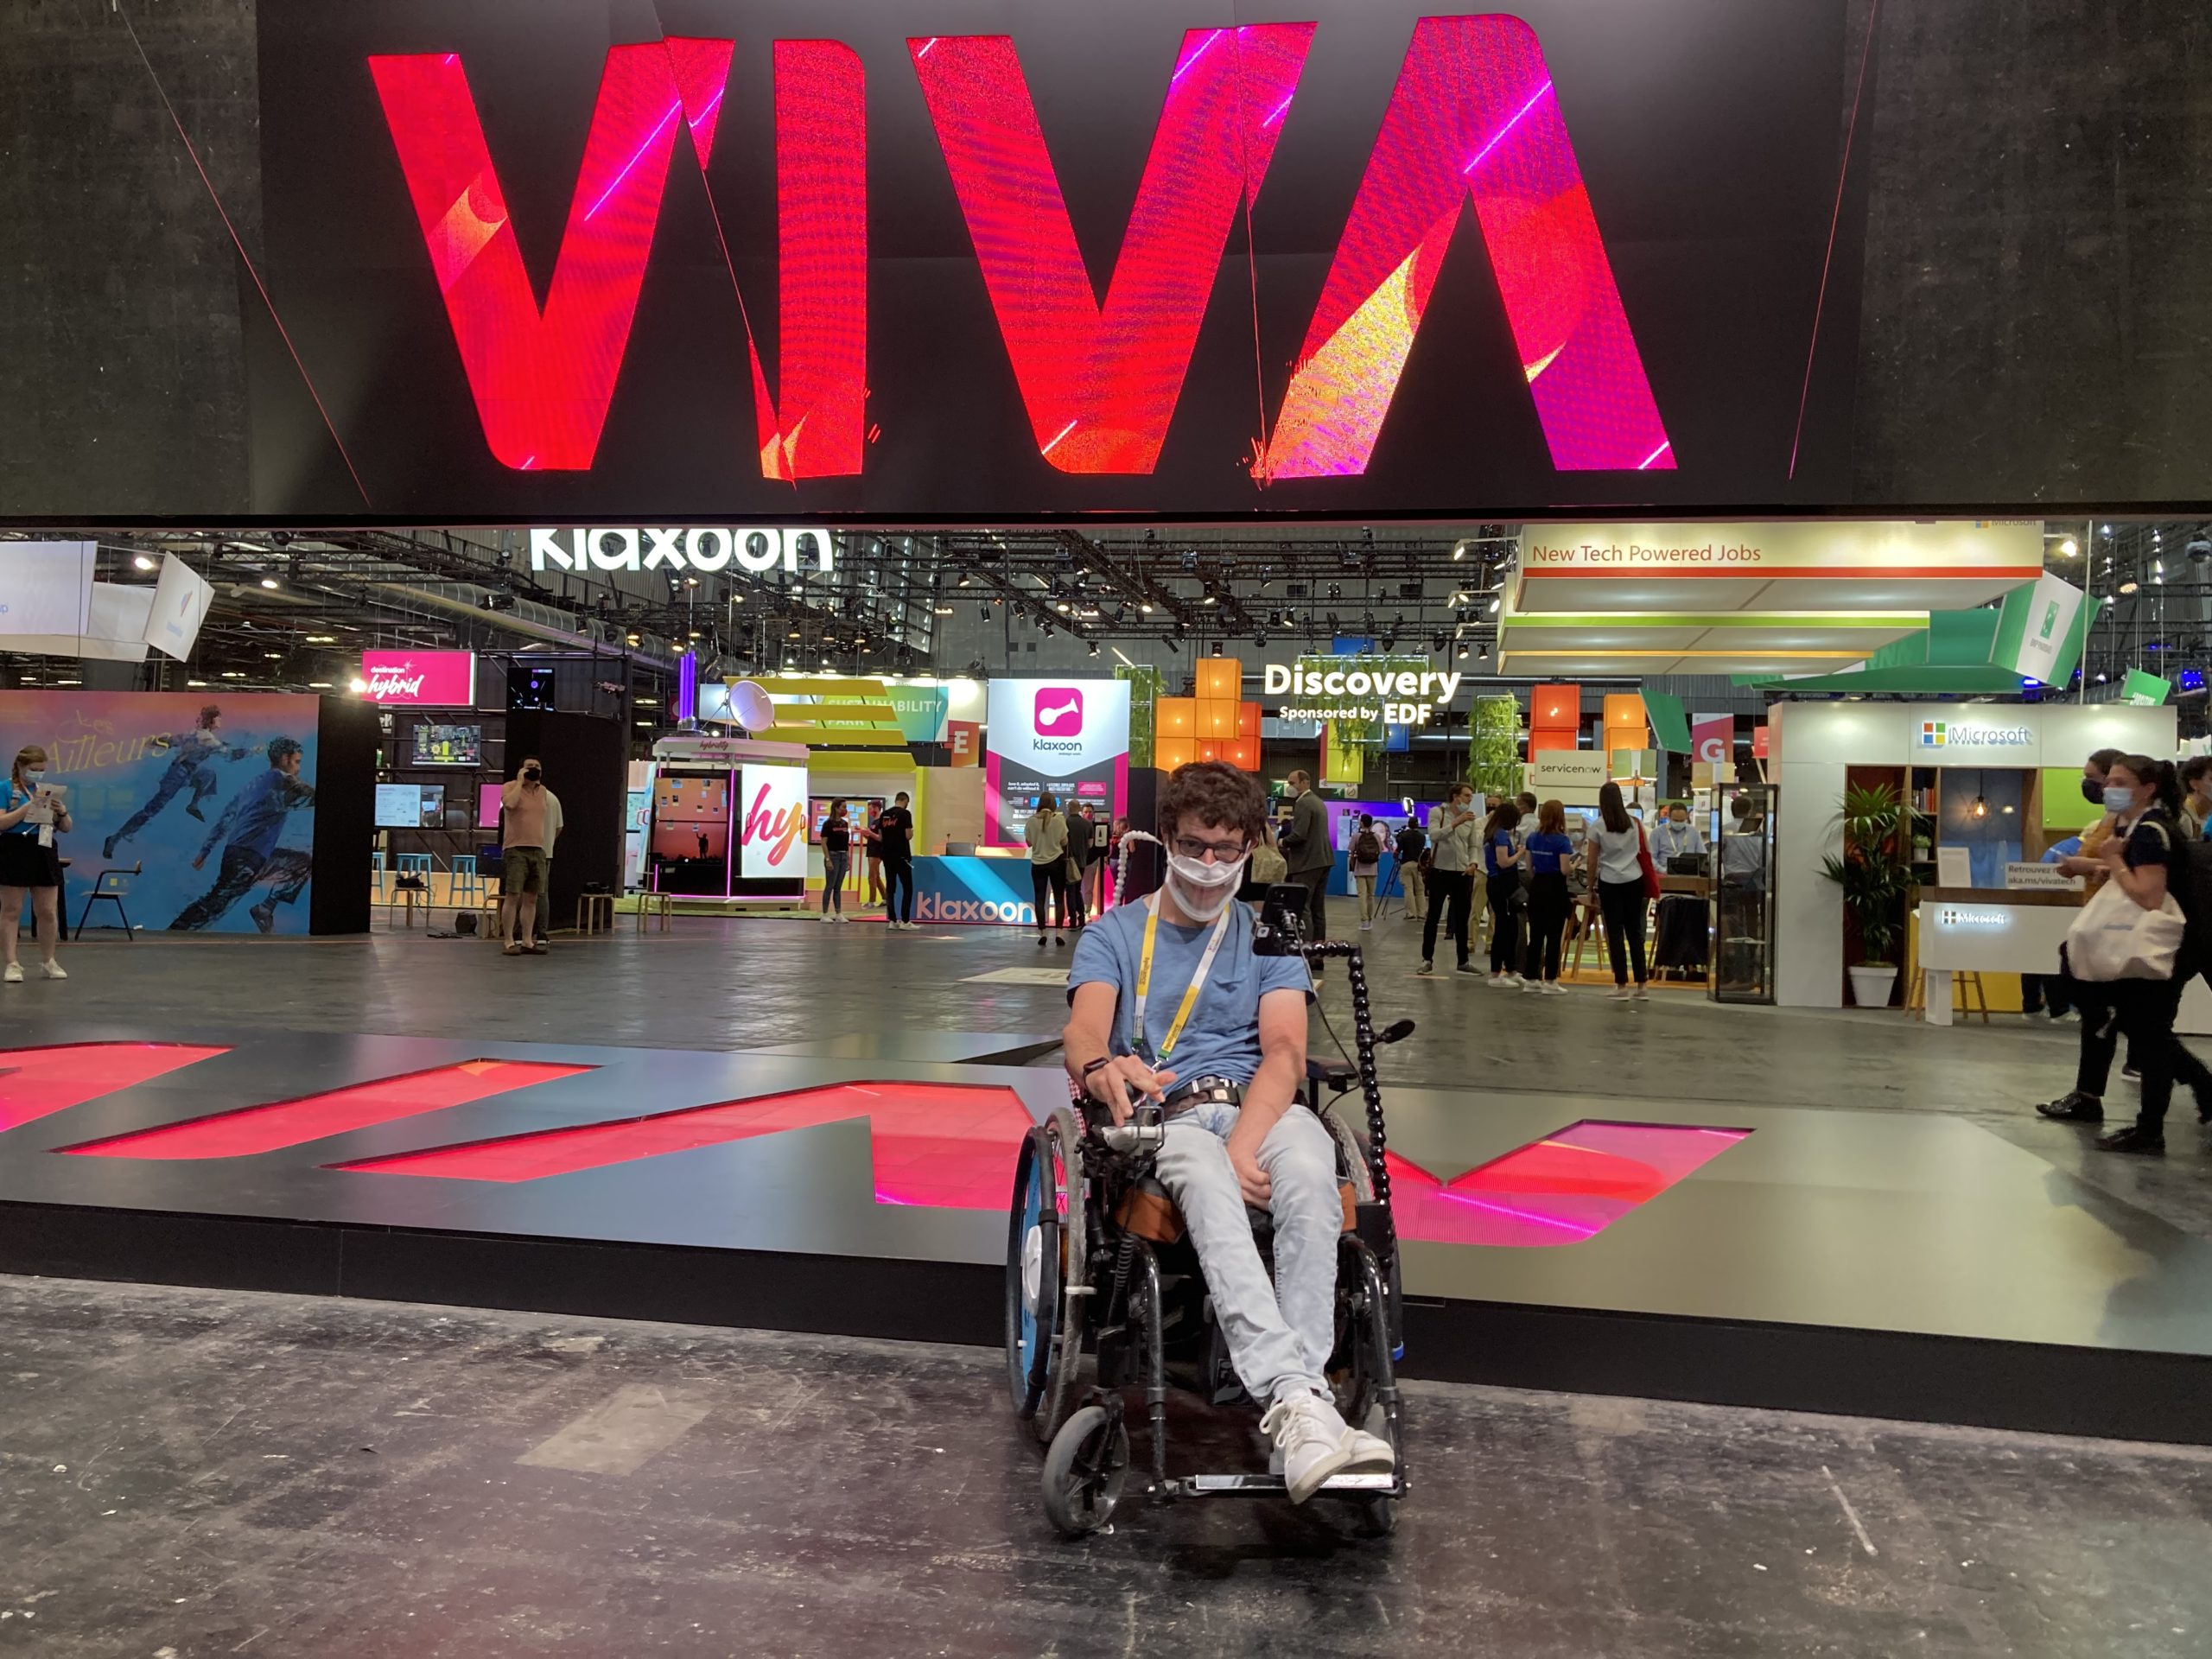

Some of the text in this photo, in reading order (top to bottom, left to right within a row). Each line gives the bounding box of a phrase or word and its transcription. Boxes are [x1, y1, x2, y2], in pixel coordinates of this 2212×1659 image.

[366, 13, 1678, 486] VIVA
[1533, 544, 1762, 562] New Tech Powered Jobs
[367, 674, 425, 700] hybrid
[1264, 664, 1462, 704] Discovery
[1279, 702, 1432, 724] Sponsored by EDF
[954, 730, 969, 754] E
[1033, 739, 1083, 751] klaxoon
[1949, 727, 2030, 743] Microsoft
[48, 732, 173, 774] Ailleurs
[1700, 738, 1726, 763] G
[1541, 763, 1602, 773] servicenow
[741, 783, 808, 867] hy
[2007, 876, 2075, 887] aka.ms/vivatech
[2008, 865, 2051, 874] Retrouvez
[916, 891, 1037, 923] klaxoon
